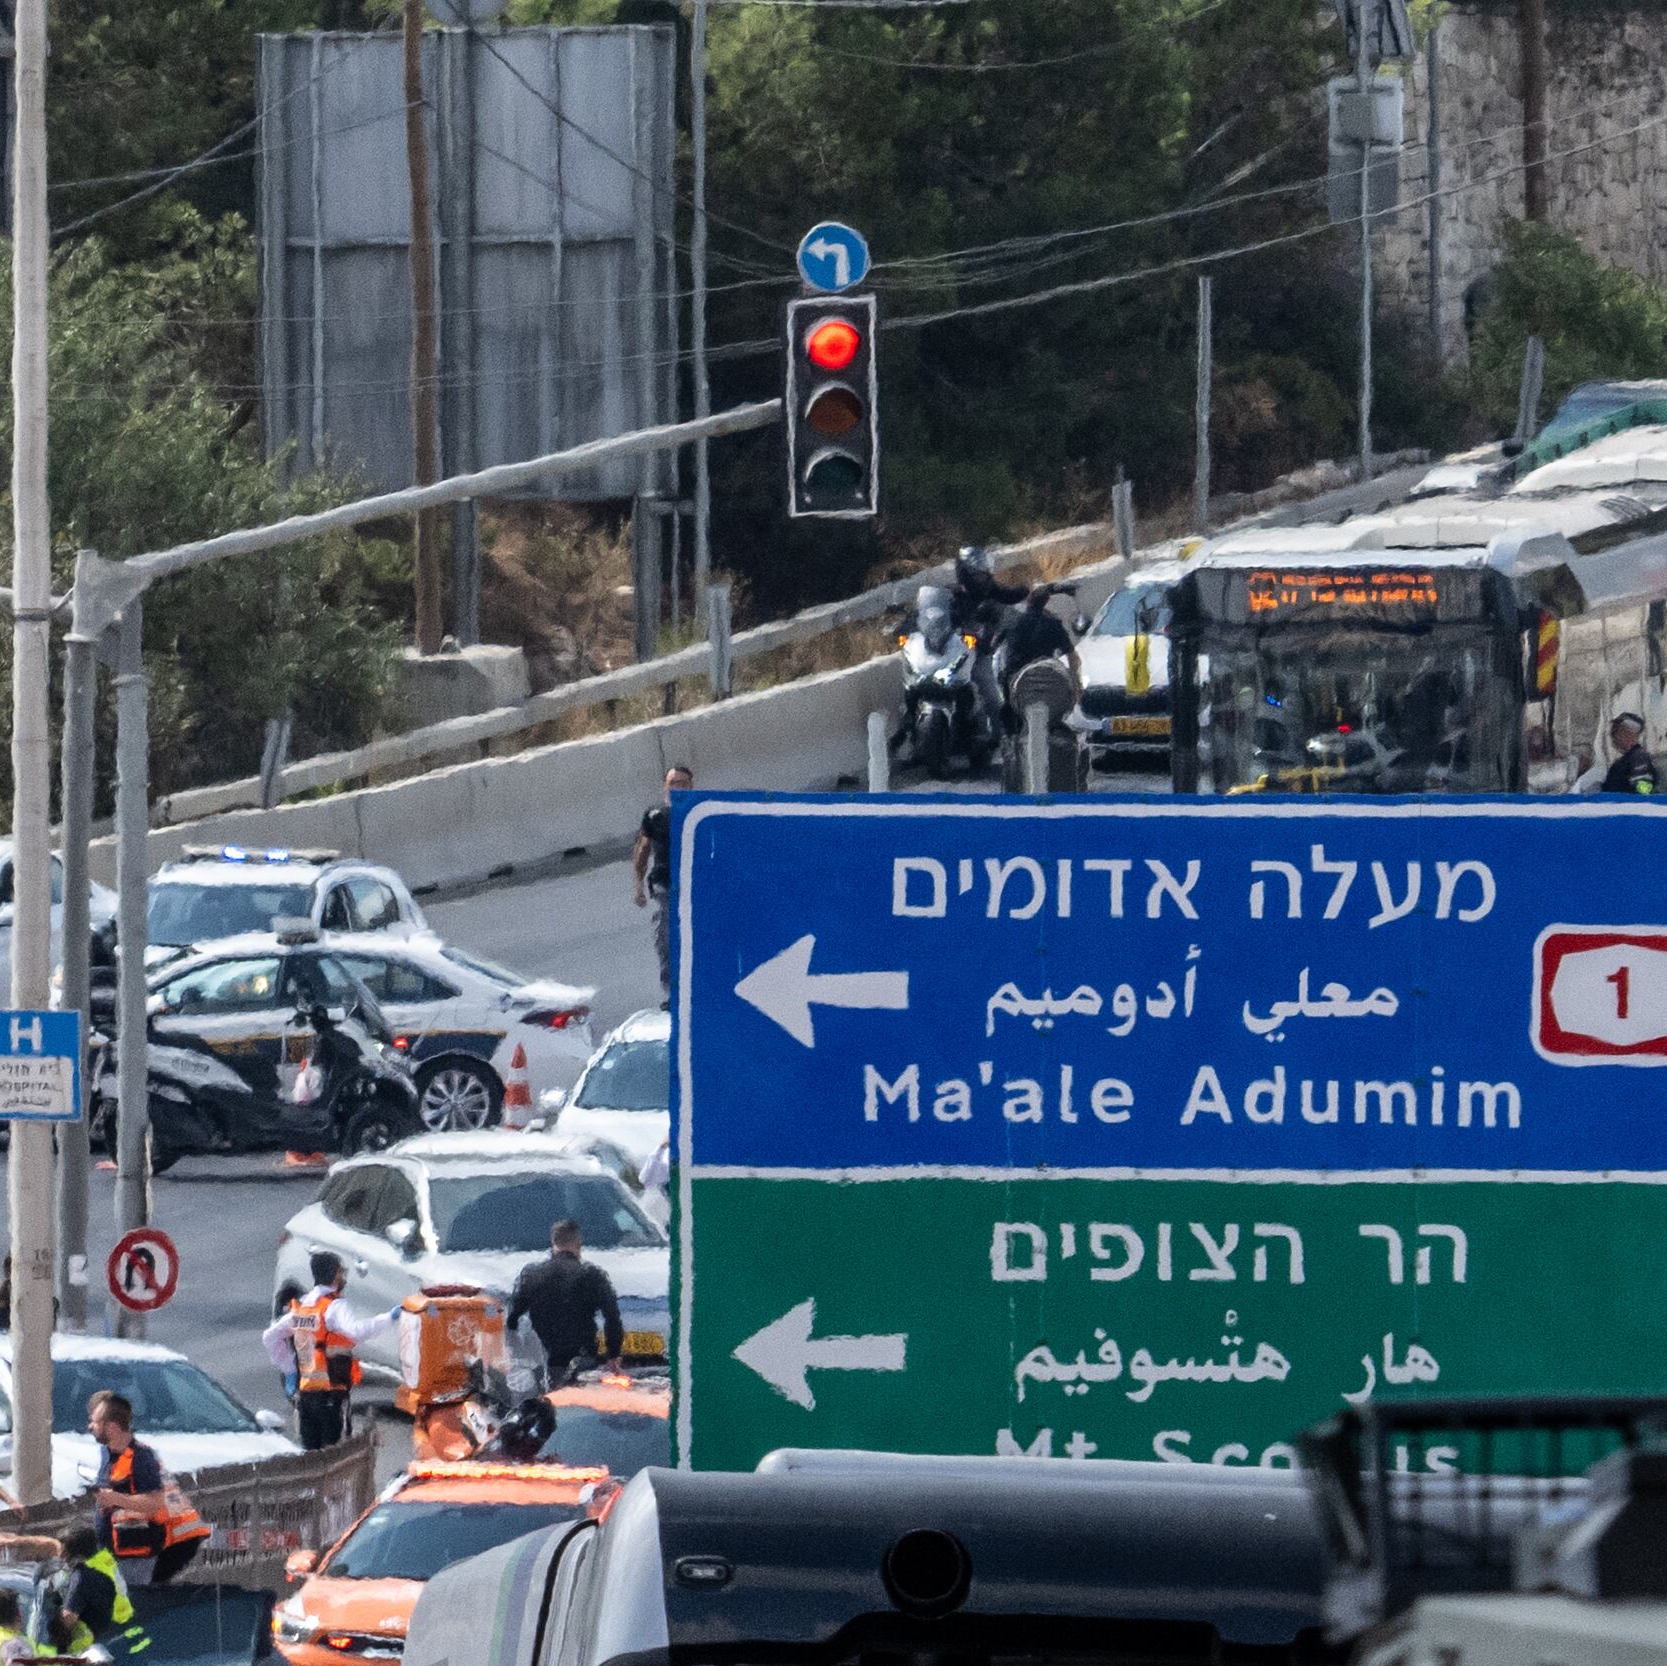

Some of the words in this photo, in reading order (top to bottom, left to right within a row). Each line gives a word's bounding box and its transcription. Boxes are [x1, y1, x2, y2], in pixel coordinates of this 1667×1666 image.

[891, 855, 1201, 920] אדומים
[1249, 843, 1497, 929] מעלה
[985, 943, 1202, 1037] أدوميم
[1242, 966, 1400, 1043] معلي
[1607, 966, 1630, 1020] 1
[10, 1016, 43, 1052] H
[863, 1060, 1135, 1124] Ma'ale
[1180, 1065, 1522, 1129] Adumim
[989, 1221, 1306, 1285] הצופים
[1358, 1222, 1468, 1285] הר
[1341, 1332, 1440, 1406] هار
